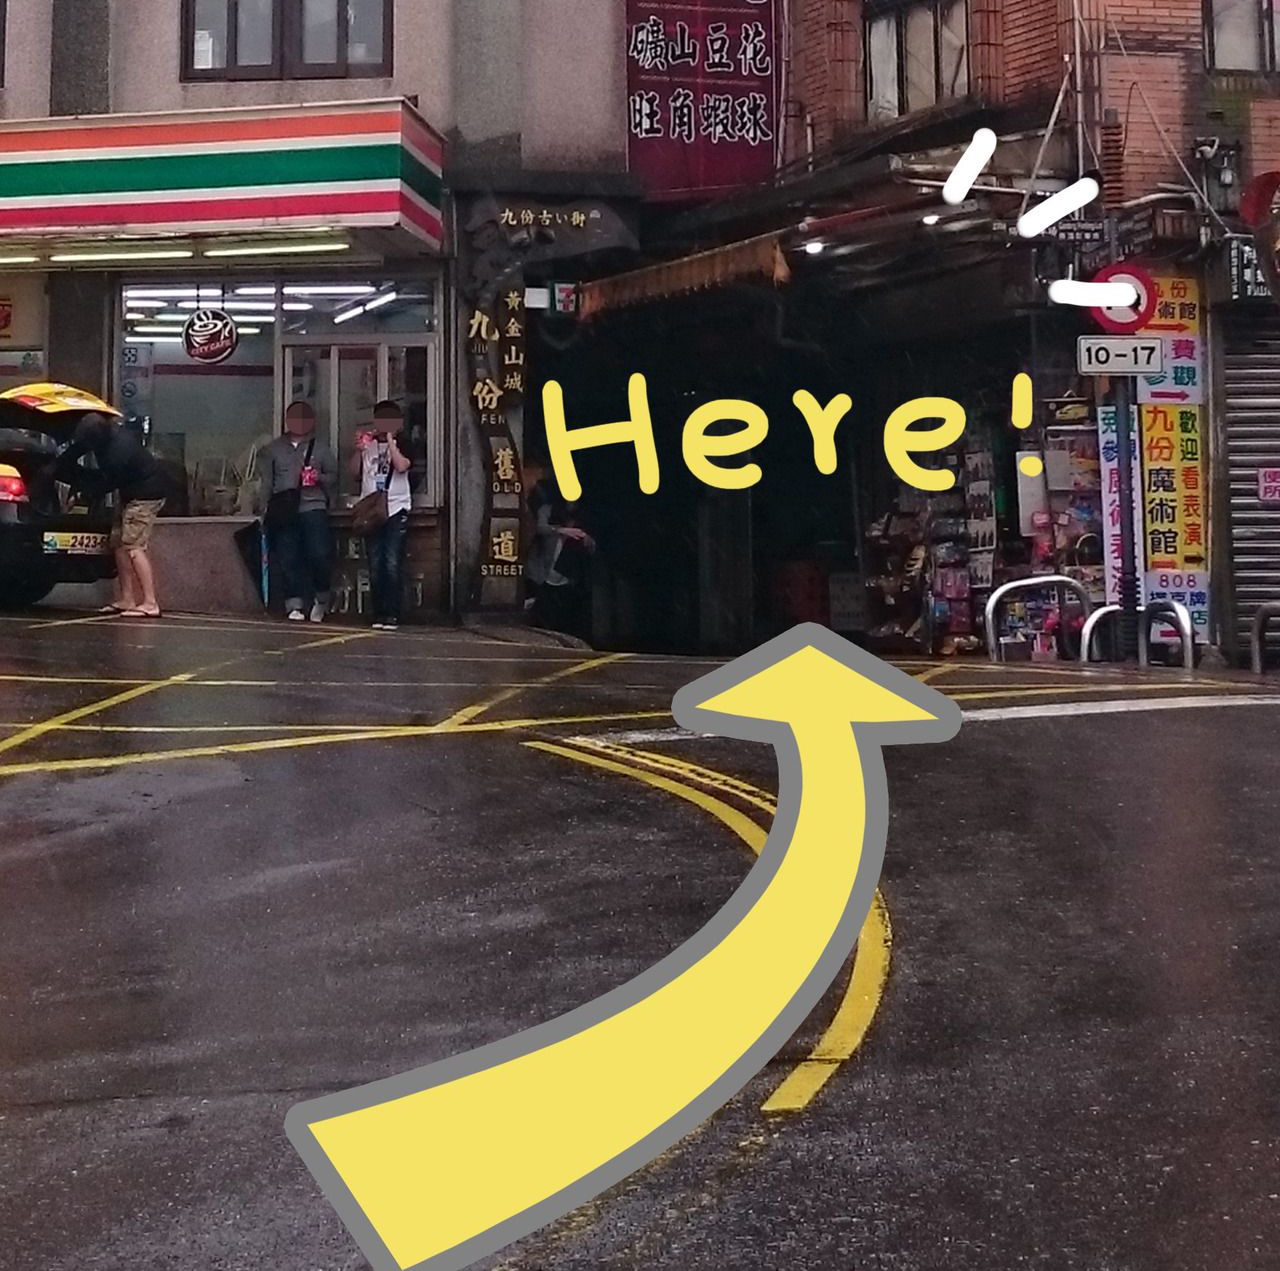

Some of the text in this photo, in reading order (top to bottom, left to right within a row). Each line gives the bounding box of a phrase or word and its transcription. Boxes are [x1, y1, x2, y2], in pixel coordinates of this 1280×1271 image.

[629, 15, 771, 76] 礦山豆花
[629, 88, 773, 146] 旺角蝦球
[1157, 300, 1197, 320] 術館
[1085, 345, 1157, 366] 10-17
[492, 482, 522, 493] OLD
[1145, 405, 1180, 555] 九份魔術館
[1178, 410, 1203, 546] 歡迎看表演
[480, 564, 525, 576] STREET
[1159, 574, 1197, 588] 808
